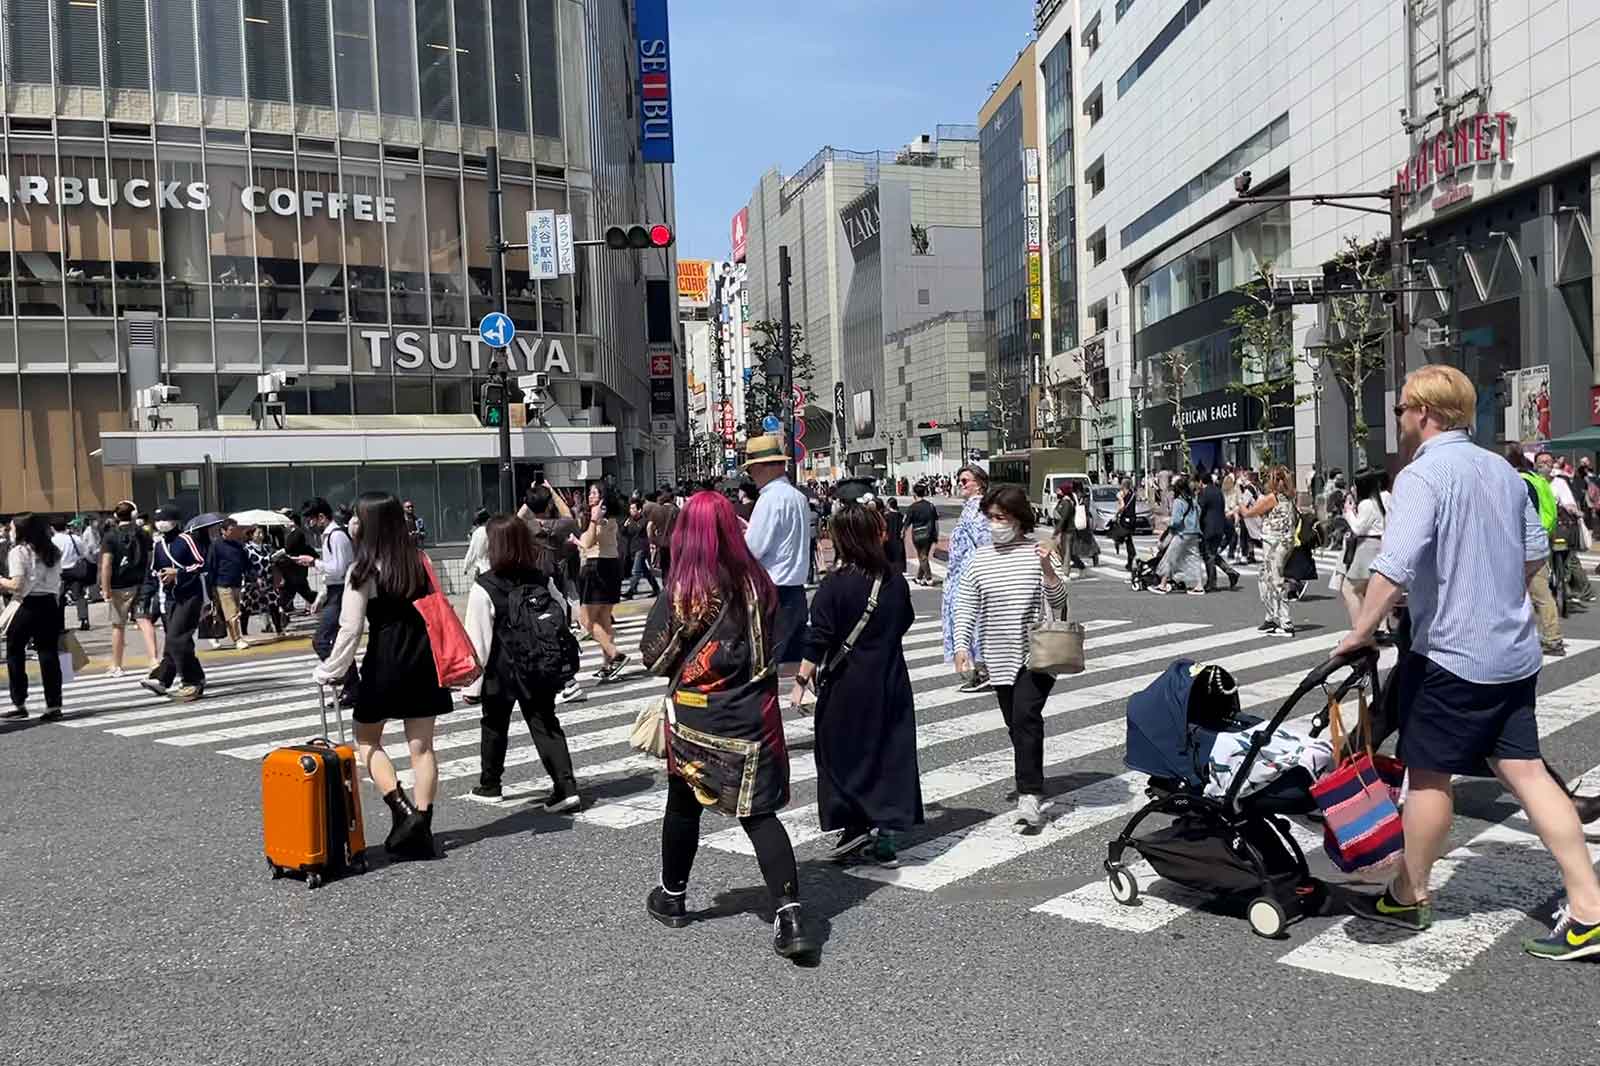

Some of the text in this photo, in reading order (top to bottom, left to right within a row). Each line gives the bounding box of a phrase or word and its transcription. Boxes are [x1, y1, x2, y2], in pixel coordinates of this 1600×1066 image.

[1396, 112, 1512, 208] MAGNET
[241, 185, 396, 223] COFFEE
[539, 216, 552, 272] 渋谷駅前
[1171, 402, 1237, 427] AERICAN EAGLE
